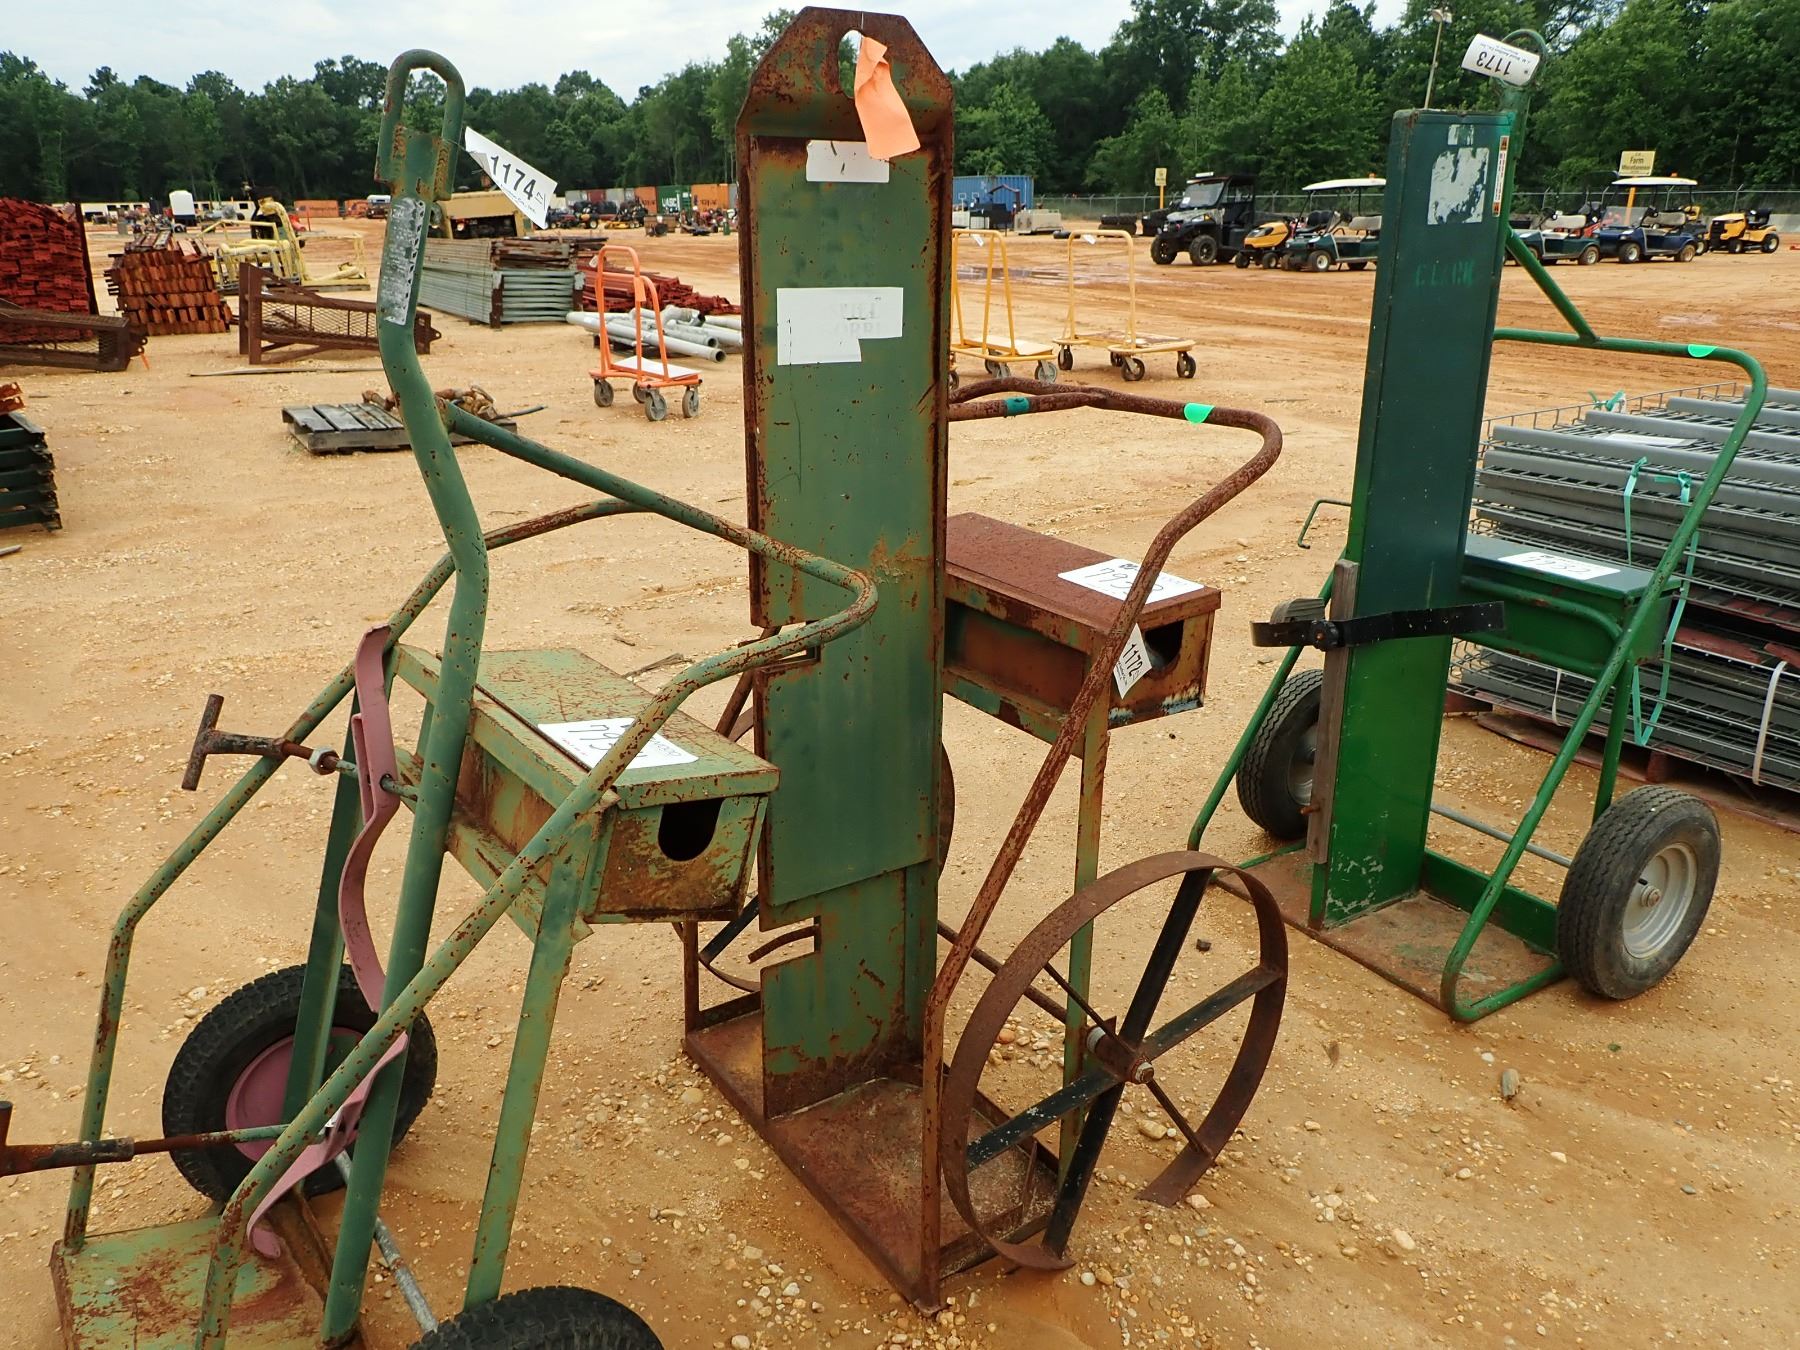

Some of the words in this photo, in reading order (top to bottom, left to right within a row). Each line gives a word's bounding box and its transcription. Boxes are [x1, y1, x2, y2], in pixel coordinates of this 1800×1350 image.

[1476, 51, 1511, 75] 1173
[490, 155, 536, 200] 1174
[1122, 643, 1143, 677] 1172
